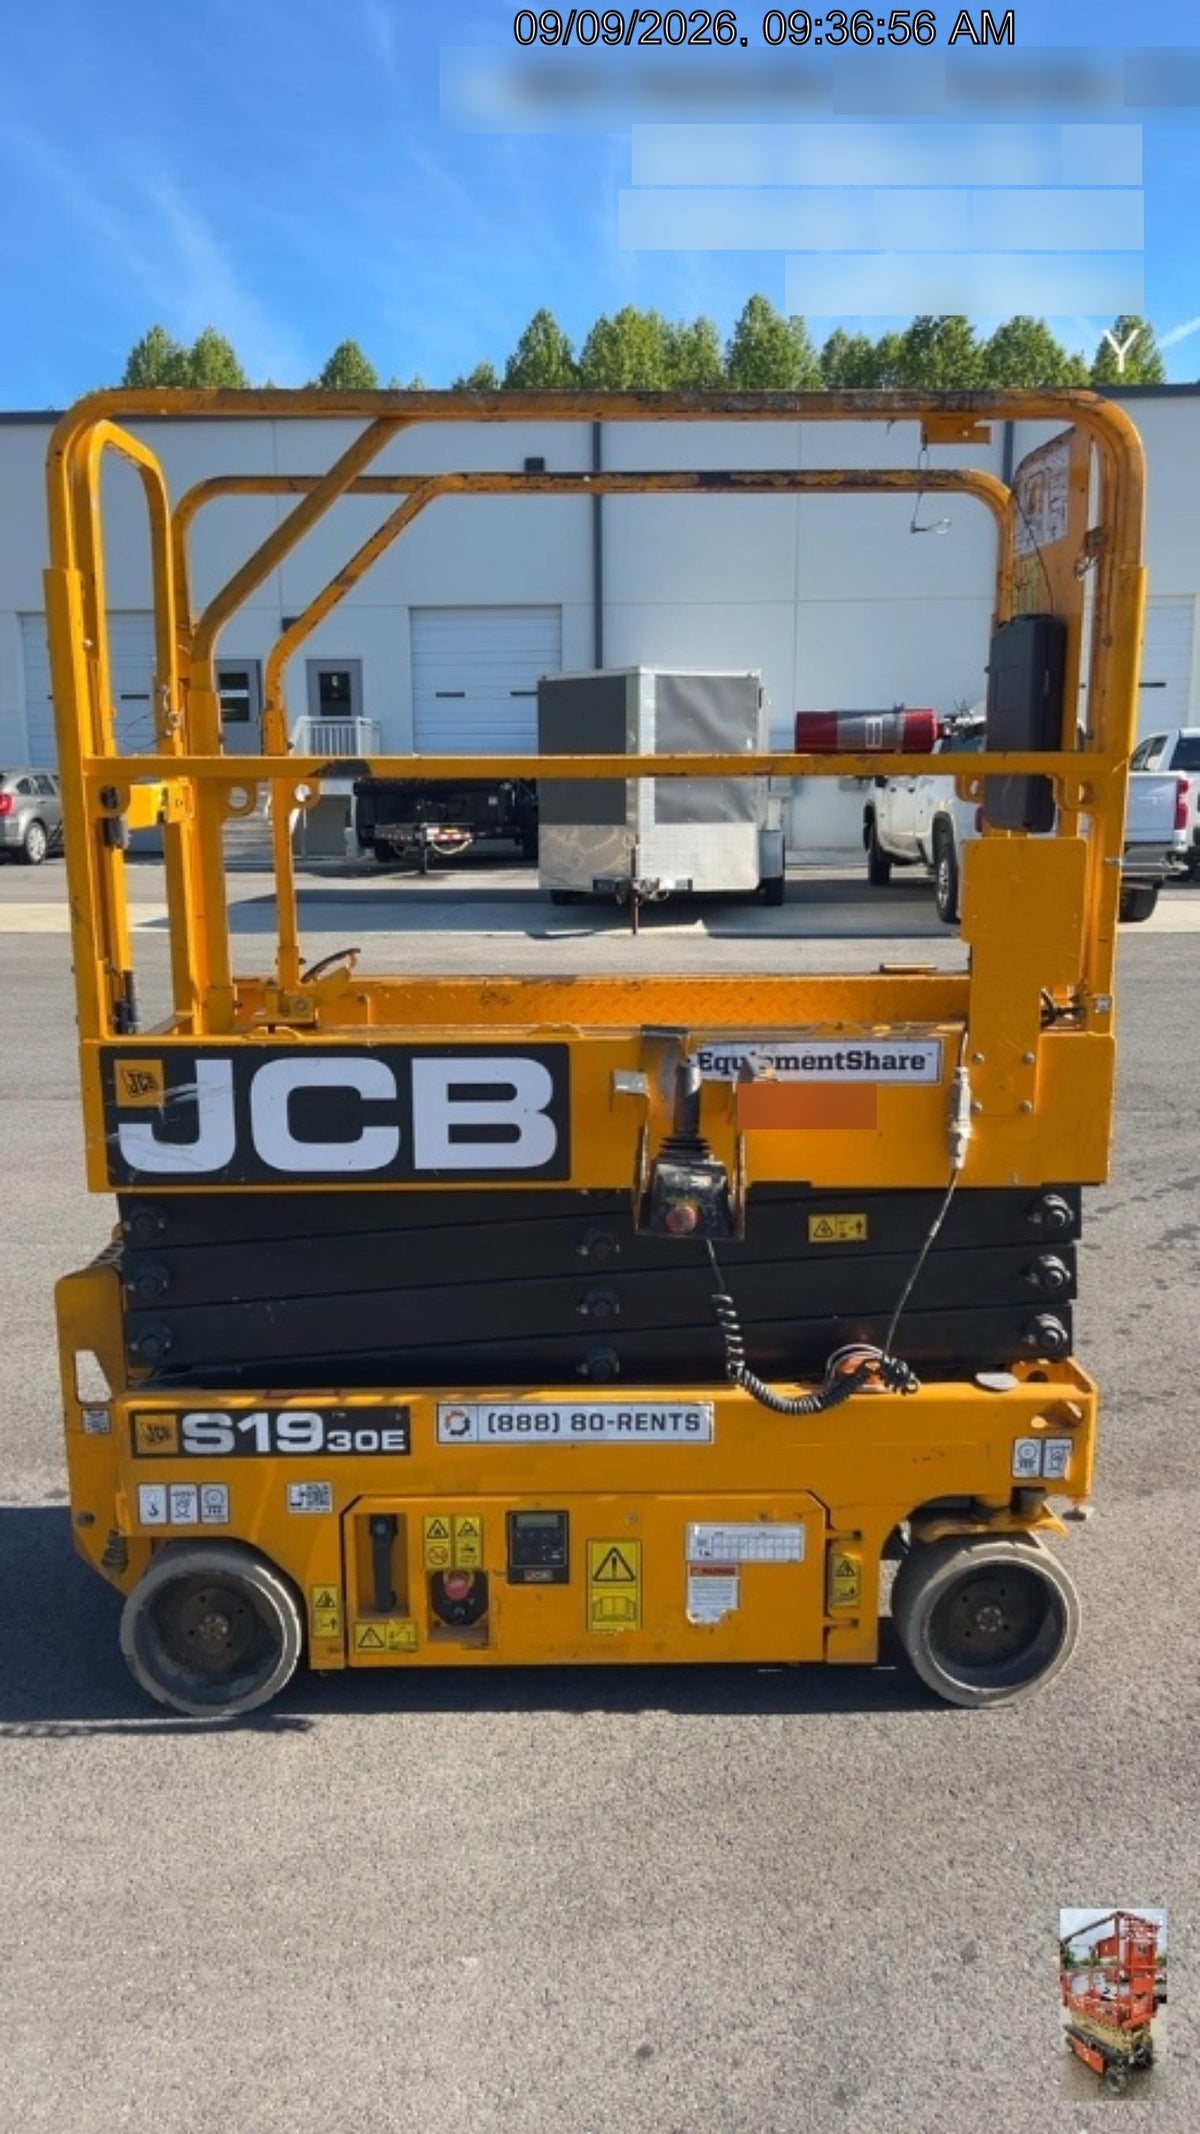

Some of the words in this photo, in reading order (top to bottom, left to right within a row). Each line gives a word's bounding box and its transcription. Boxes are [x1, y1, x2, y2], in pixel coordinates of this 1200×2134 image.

[697, 1050, 926, 1075] EqumentShare
[118, 1057, 557, 1172] JCB
[487, 1411, 561, 1433] (888)
[570, 1411, 701, 1433] 80-RENTS
